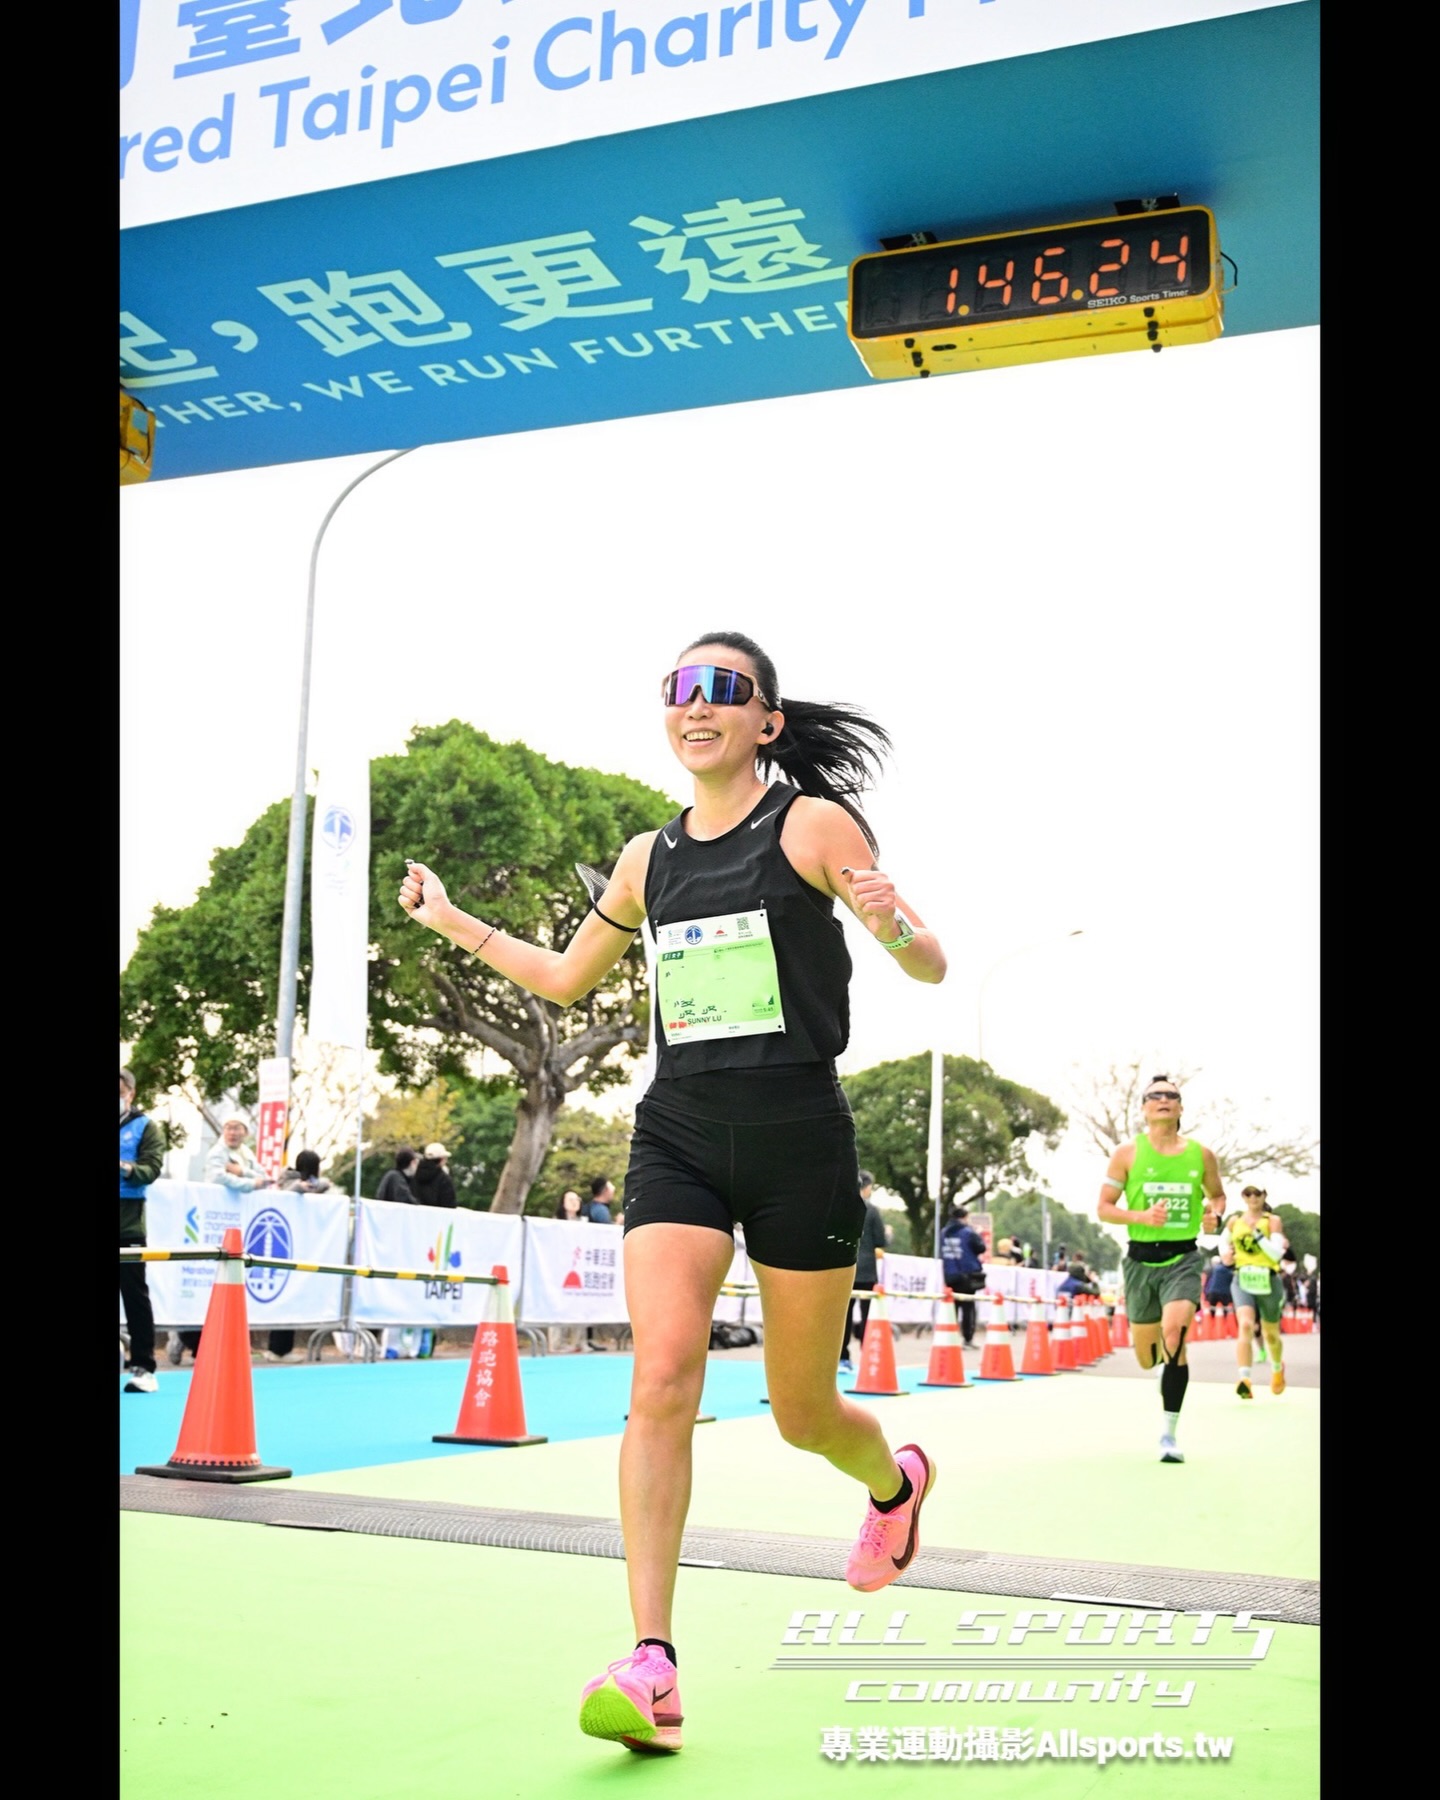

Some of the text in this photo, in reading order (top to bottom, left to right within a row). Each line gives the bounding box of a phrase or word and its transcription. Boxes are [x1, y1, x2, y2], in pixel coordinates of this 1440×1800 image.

[259, 35, 511, 149] Taipei
[533, 0, 867, 91] Charity
[1086, 289, 1190, 309] SEIKO Sports Timer
[302, 370, 414, 401] WE
[419, 347, 558, 387] RUN
[687, 1017, 711, 1026] SUNNY
[711, 1015, 723, 1023] LU
